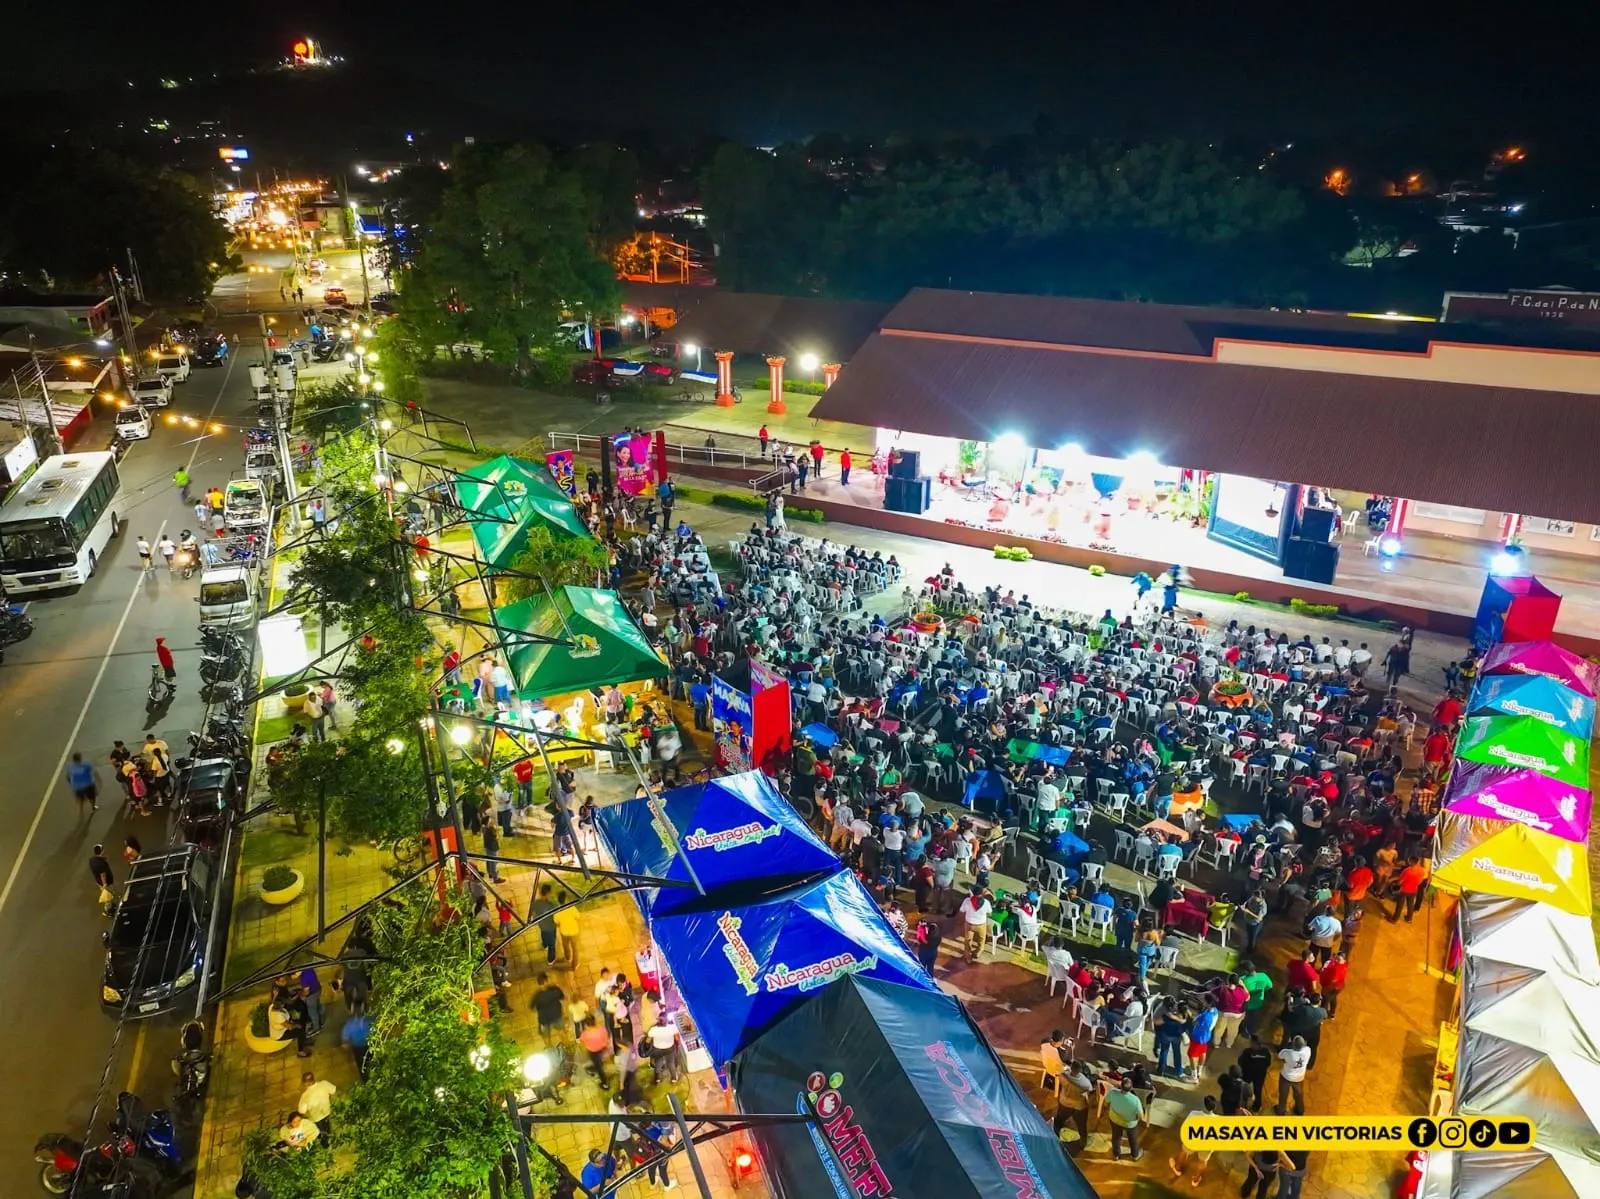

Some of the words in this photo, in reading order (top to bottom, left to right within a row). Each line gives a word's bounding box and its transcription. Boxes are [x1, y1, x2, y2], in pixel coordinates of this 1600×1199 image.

[1479, 795, 1539, 820] Nicaragua
[687, 822, 762, 848] Nicaragua
[1473, 858, 1540, 882] Nicaragua
[718, 912, 759, 976] Nicaragua
[766, 953, 855, 989] Nicaragua
